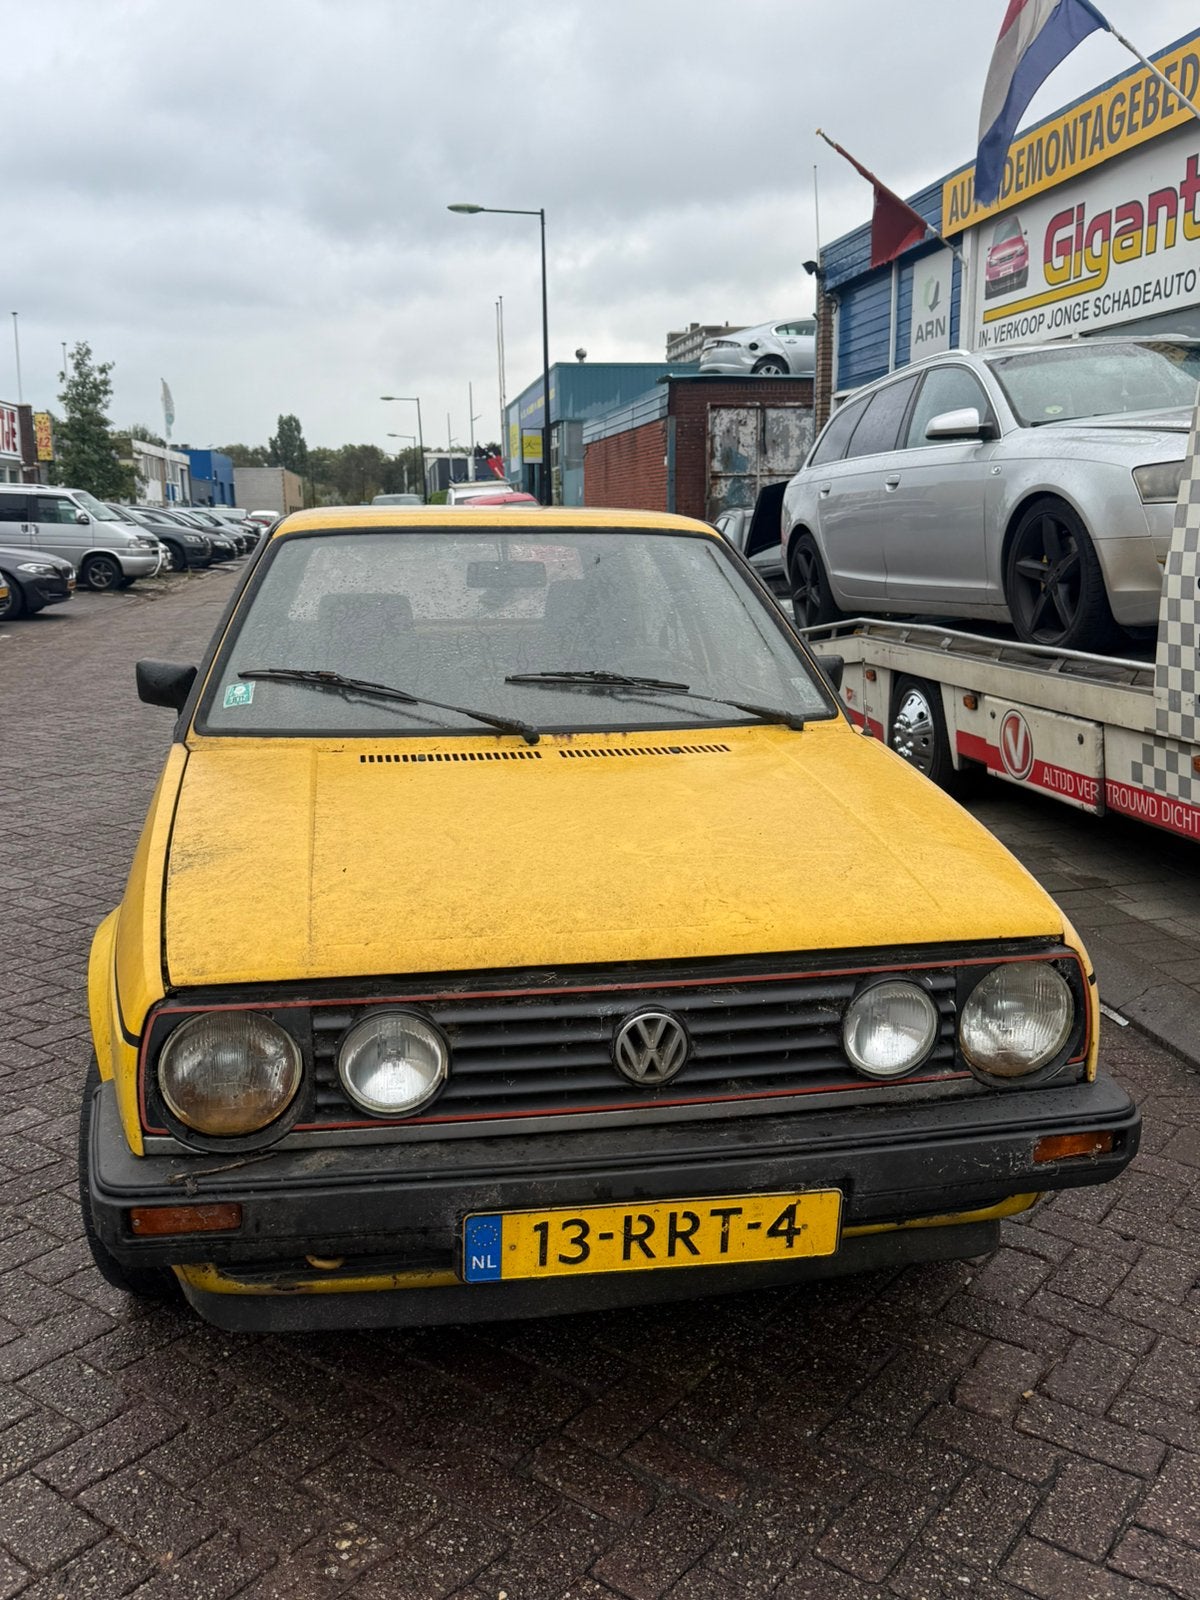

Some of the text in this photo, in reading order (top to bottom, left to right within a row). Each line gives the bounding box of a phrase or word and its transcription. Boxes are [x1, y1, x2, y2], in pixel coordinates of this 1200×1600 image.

[949, 52, 1199, 226] AUDEMONTAGEBED
[915, 315, 946, 345] ARN
[978, 267, 1200, 348] IN- VERKOOP JONGE SCHADEAUTO
[1042, 766, 1075, 793] ALTIJD
[1161, 801, 1200, 833] DICHT
[471, 1254, 497, 1271] NL
[533, 1200, 802, 1267] 13-RRT-4
